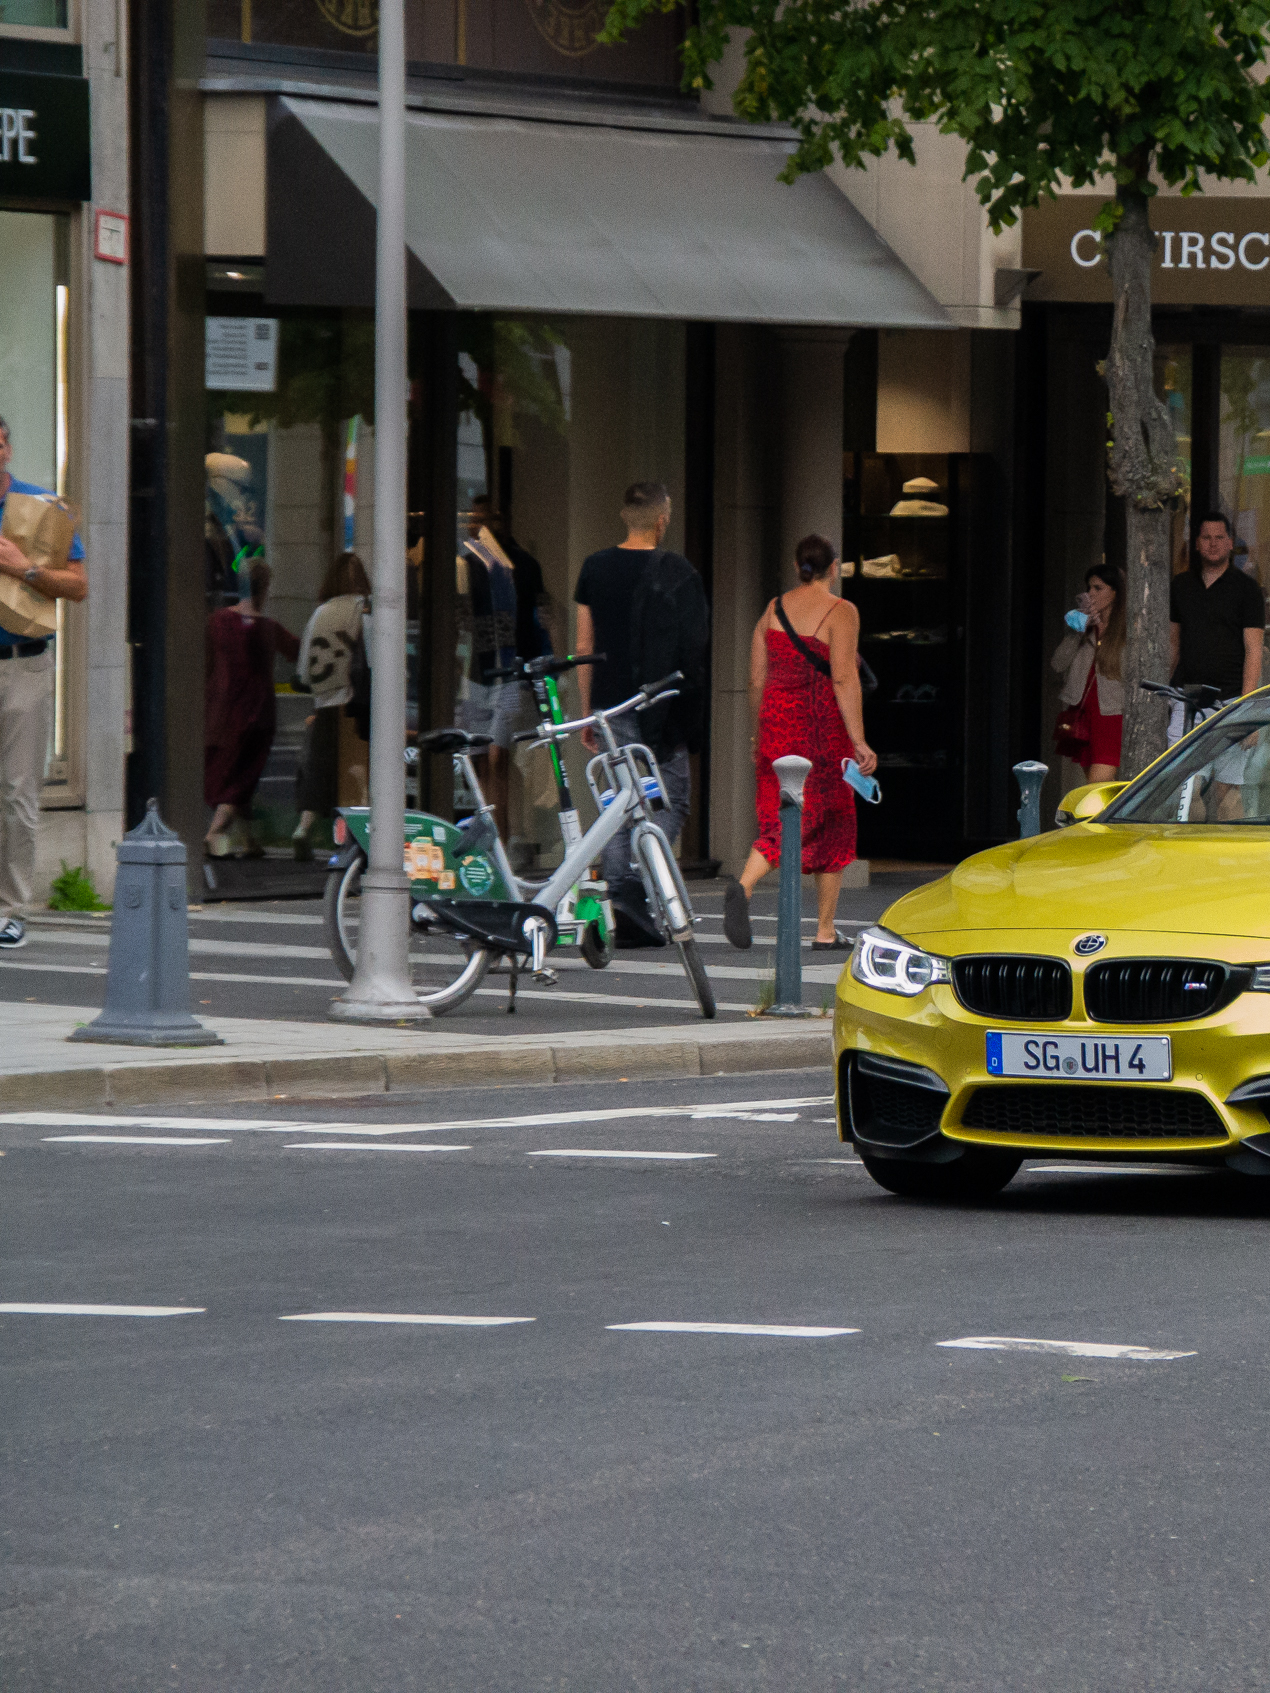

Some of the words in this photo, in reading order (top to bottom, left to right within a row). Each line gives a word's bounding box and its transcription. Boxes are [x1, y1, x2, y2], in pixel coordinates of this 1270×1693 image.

[0, 107, 37, 164] PE
[991, 1057, 998, 1067] D
[1023, 1039, 1060, 1071] SG
[1081, 1042, 1121, 1074] UH
[1127, 1043, 1146, 1074] 4
